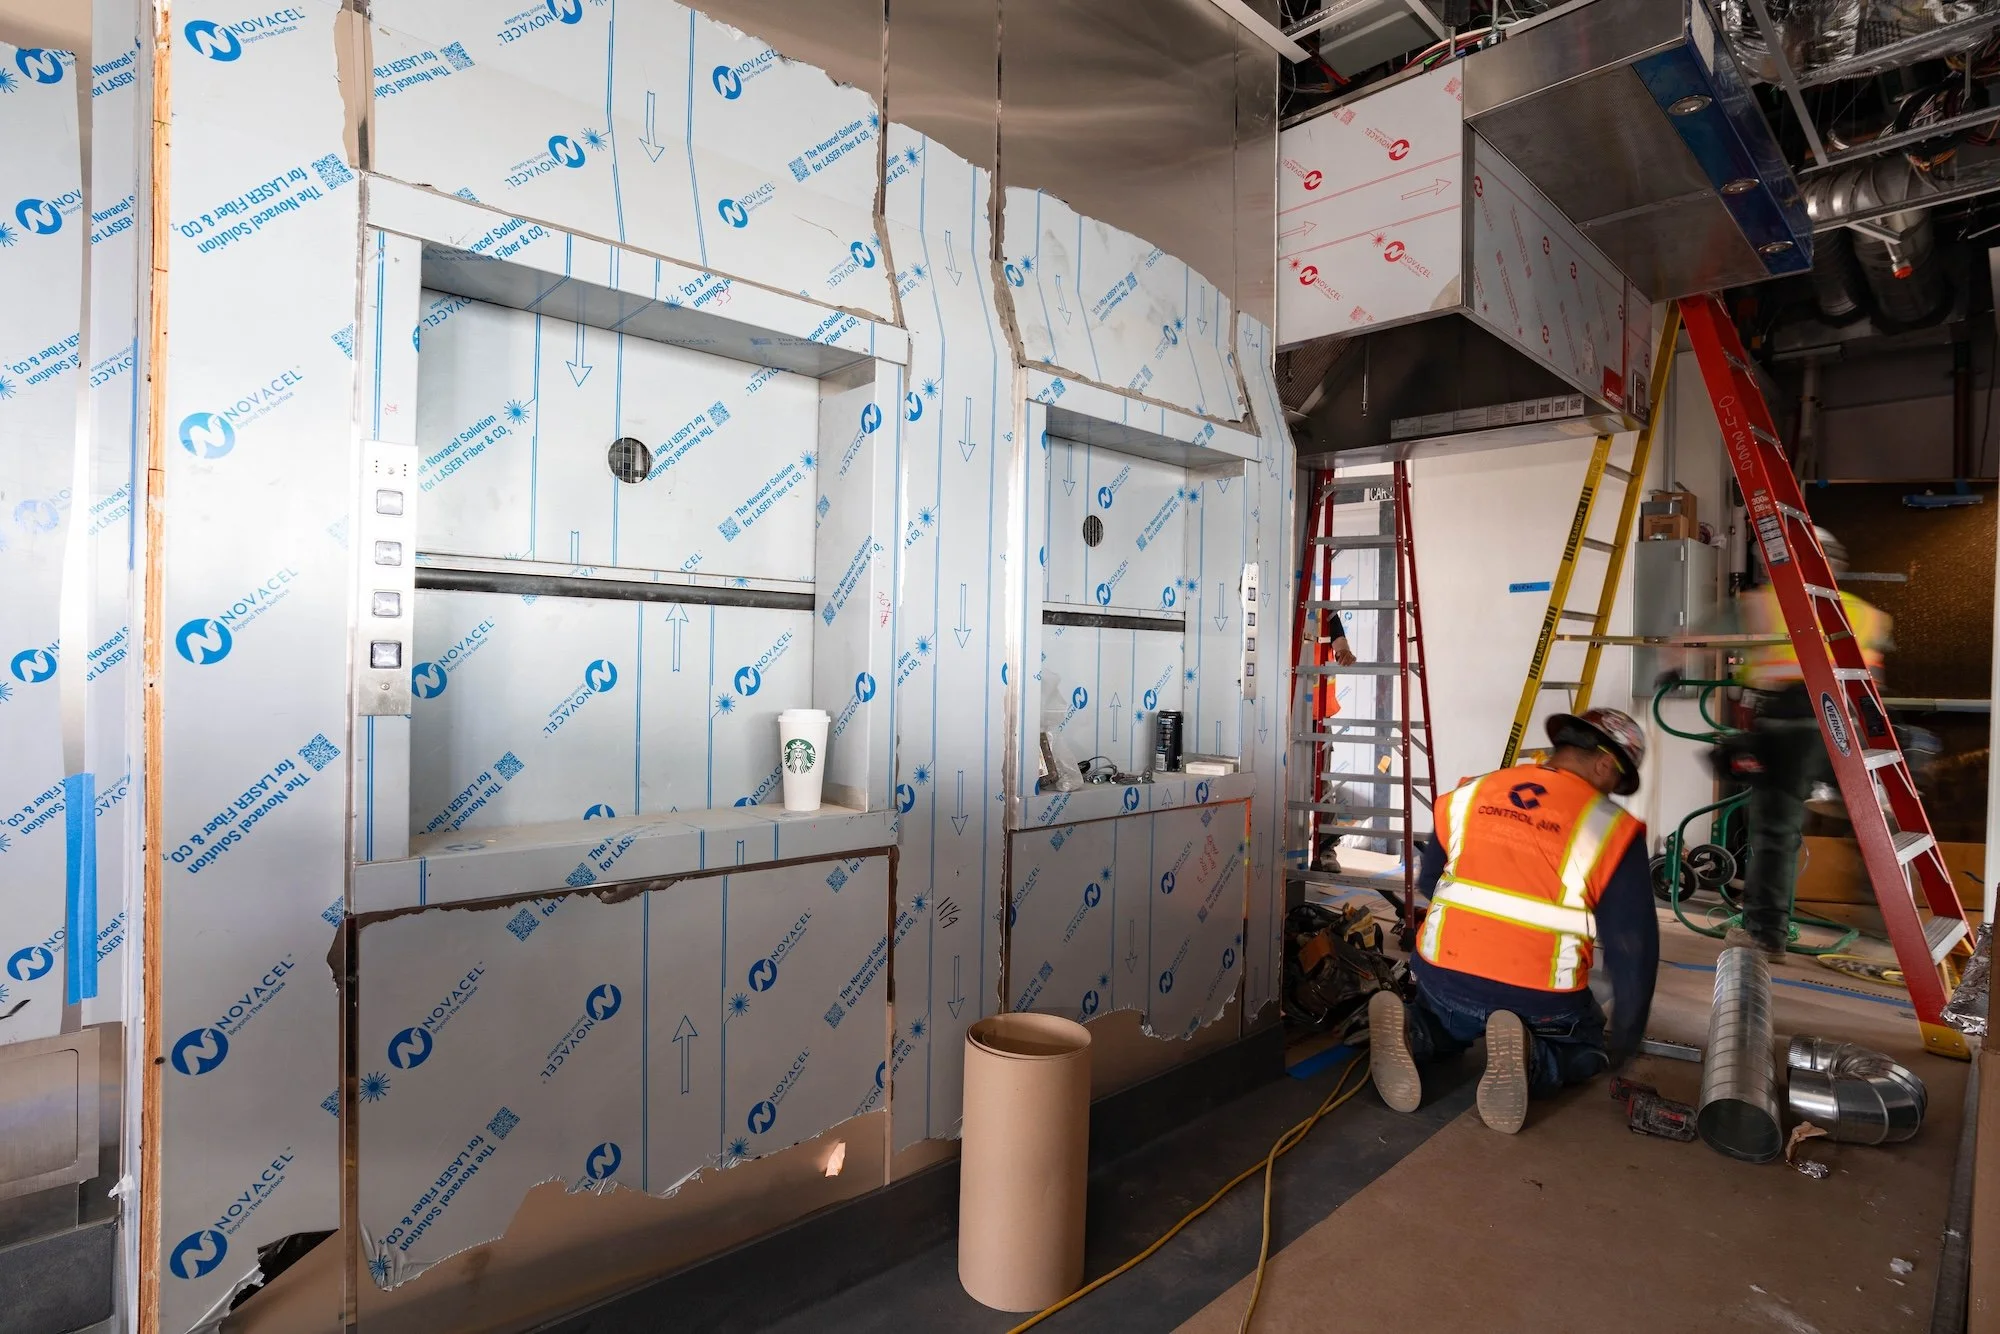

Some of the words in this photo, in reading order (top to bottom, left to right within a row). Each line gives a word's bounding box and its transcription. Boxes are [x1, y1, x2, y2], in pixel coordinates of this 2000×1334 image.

[229, 7, 305, 38] NOVACEL
[240, 33, 264, 44] Beyond
[274, 25, 297, 36] Surface
[497, 11, 554, 45] NOVACEL
[92, 53, 131, 76] Novacel
[390, 55, 420, 73] LASER
[421, 50, 438, 61] for
[735, 46, 780, 76] NOVACEL
[101, 72, 135, 91] LASER
[393, 71, 433, 92] Novacel
[430, 65, 451, 77] The
[804, 149, 818, 160] The
[816, 132, 840, 153] Novacel
[838, 120, 863, 138] Solution
[1365, 127, 1394, 150] NOVACEL
[812, 162, 823, 173] for
[821, 148, 842, 167] LASER
[839, 140, 856, 154] Fiber
[287, 167, 308, 182] for
[505, 157, 558, 187] NOVACEL
[245, 177, 288, 204] LASER
[298, 186, 323, 202] The
[739, 182, 776, 209] NOVACEL
[91, 199, 131, 223] Novacel
[200, 214, 215, 226] &
[214, 197, 249, 219] Fiber
[250, 197, 300, 229] Novacel
[100, 217, 133, 238] LASER
[198, 222, 251, 253] Solution
[495, 241, 521, 263] Fiber
[519, 235, 530, 245] &
[827, 259, 859, 287] NOVACEL
[1400, 253, 1431, 278] NOVACEL
[693, 283, 726, 308] Solution
[694, 278, 704, 288] &
[1314, 277, 1343, 301] NOVACEL
[39, 342, 66, 360] Fiber
[824, 330, 842, 347] Fiber
[26, 360, 70, 385] Solution
[28, 356, 40, 365] &
[224, 370, 302, 420] NOVACEL
[671, 422, 696, 444] LASER
[694, 414, 706, 425] for
[699, 425, 714, 438] The
[426, 437, 462, 466] Novacel
[460, 415, 496, 442] Solution
[654, 440, 674, 457] Fiber
[674, 435, 701, 461] Novacel
[839, 431, 867, 476] NOVACEL
[420, 479, 435, 492] for
[434, 457, 465, 481] LASER
[462, 442, 486, 461] Fiber
[484, 435, 495, 445] &
[644, 456, 676, 481] Solution
[734, 505, 749, 517] The
[746, 483, 771, 507] Novacel
[769, 463, 795, 486] Solution
[1106, 465, 1131, 491] NOVACEL
[742, 517, 754, 528] for
[751, 498, 773, 519] LASER
[771, 485, 788, 501] Fiber
[1570, 507, 1586, 543] LEANSAFE
[832, 588, 841, 601] The
[839, 561, 856, 589] Novacel
[854, 535, 872, 562] Solution
[1106, 559, 1129, 587] NOVACEL
[221, 565, 297, 626] NOVACEL
[836, 598, 844, 610] for
[842, 576, 857, 600] LASER
[855, 560, 867, 579] Fiber
[254, 605, 267, 615] The
[87, 632, 125, 661] Novacel
[438, 621, 494, 667] NOVACEL
[461, 652, 471, 661] The
[468, 637, 488, 655] Surface
[755, 632, 793, 670] NOVACEL
[94, 649, 127, 674] LASER
[1151, 665, 1173, 693] NOVACEL
[543, 689, 592, 733] NOVACEL
[832, 699, 860, 737] NOVACEL
[1826, 704, 1846, 744] WERNER
[274, 759, 295, 776] for
[1502, 741, 1516, 769] ANSAFE
[234, 774, 277, 810] LASER
[284, 773, 310, 792] The
[476, 771, 492, 785] for
[483, 782, 503, 798] The
[22, 805, 35, 814] &
[33, 786, 62, 807] Fiber
[447, 784, 479, 812] LASER
[21, 803, 67, 834] Solution
[203, 807, 238, 836] Fiber
[238, 791, 288, 833] Novacel
[426, 810, 451, 834] Fiber
[449, 797, 486, 831] Novacel
[1478, 805, 1533, 826] CONTROL
[1536, 820, 1561, 833] AIR
[188, 830, 241, 873] Solution
[189, 834, 205, 845] &
[588, 844, 607, 861] The
[599, 857, 614, 872] for
[1009, 867, 1040, 906] NOVACEL
[542, 898, 557, 917] for
[771, 913, 812, 961] NOVACEL
[1063, 906, 1088, 943] NOVACEL
[839, 985, 852, 1000] The
[850, 955, 874, 986] Novacel
[846, 995, 857, 1008] for
[855, 970, 876, 996] LASER
[216, 961, 294, 1030] NOVACEL
[227, 1013, 252, 1036] Beyond
[249, 1003, 264, 1014] The
[262, 982, 286, 1004] Surface
[422, 968, 485, 1029] NOVACEL
[431, 1014, 452, 1034] Beyond
[448, 1005, 460, 1015] The
[458, 986, 478, 1005] Surface
[540, 1019, 594, 1077] NOVACEL
[769, 1052, 810, 1102] NOVACEL
[467, 1135, 484, 1152] for
[475, 1145, 497, 1163] The
[435, 1151, 470, 1187] LASER
[215, 1155, 293, 1230] NOVACEL
[439, 1164, 479, 1207] Novacel
[226, 1211, 251, 1235] Beyond
[249, 1199, 263, 1211] The
[261, 1175, 285, 1199] Surface
[411, 1187, 439, 1216] Fiber
[400, 1206, 442, 1251] Solution
[401, 1216, 413, 1225] &
